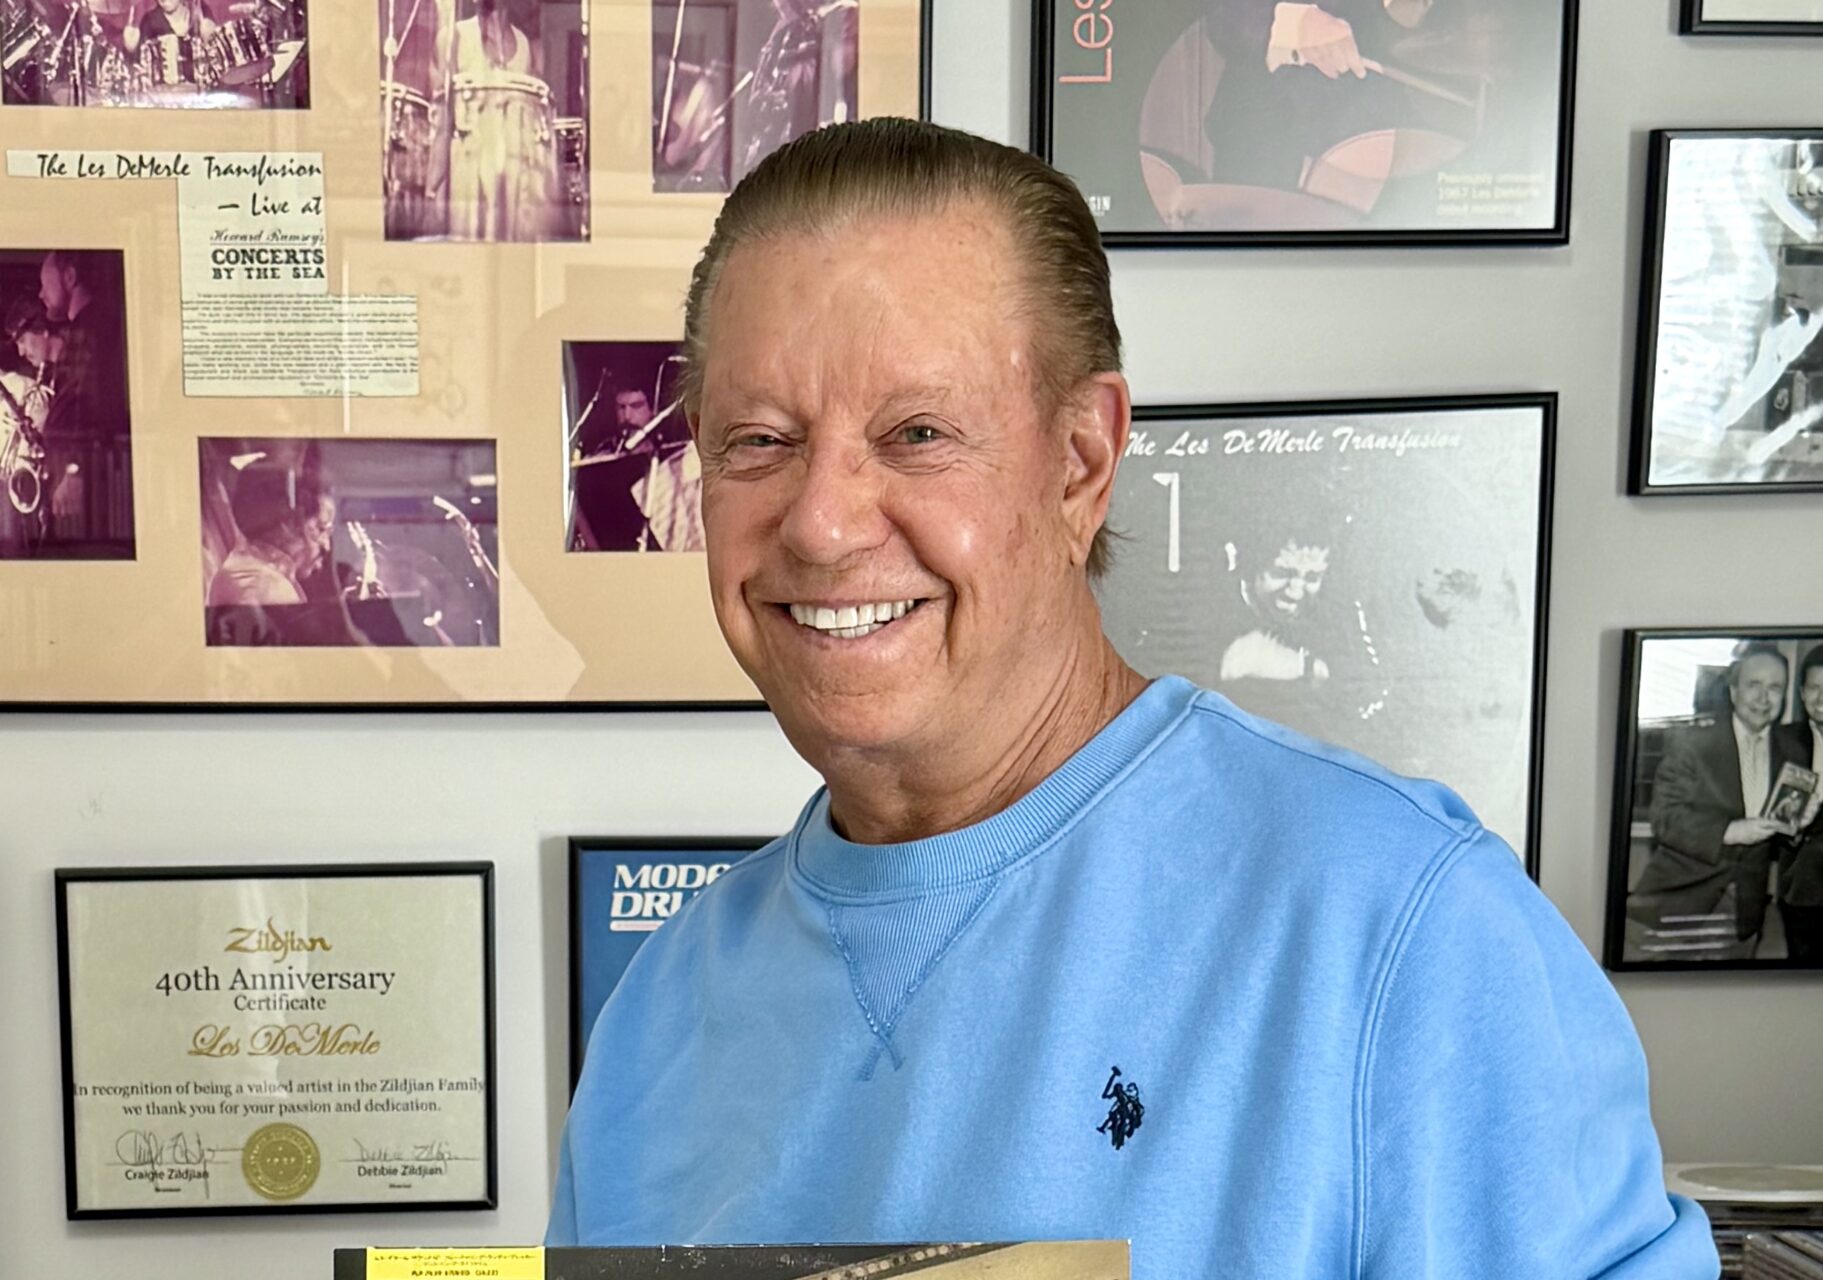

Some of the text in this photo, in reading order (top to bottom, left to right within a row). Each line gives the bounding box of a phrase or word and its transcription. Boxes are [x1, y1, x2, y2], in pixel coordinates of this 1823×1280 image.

[1058, 0, 1113, 82] Le
[38, 153, 322, 185] The Les DeMerle Transfusion
[251, 193, 322, 216] Live at
[211, 248, 325, 265] CONCERTS
[212, 267, 325, 280] BY THE SEA
[1165, 431, 1209, 456] Les
[1332, 426, 1462, 457] Transfusion
[224, 916, 332, 963] Zildjian
[155, 966, 395, 996] 40th Anniversary
[234, 994, 327, 1012] Certificate
[187, 1024, 240, 1058] Les
[92, 1082, 172, 1098] recognition
[175, 1082, 190, 1095] of
[193, 1081, 233, 1097] being
[235, 1084, 243, 1094] a
[297, 1080, 333, 1093] artist
[337, 1080, 351, 1093] in
[355, 1080, 377, 1093] the
[380, 1079, 434, 1094] Zildjian
[439, 1078, 485, 1094] Family
[123, 1098, 442, 1117] we thank you for your passion and dedication.
[357, 1164, 398, 1177] Debbie
